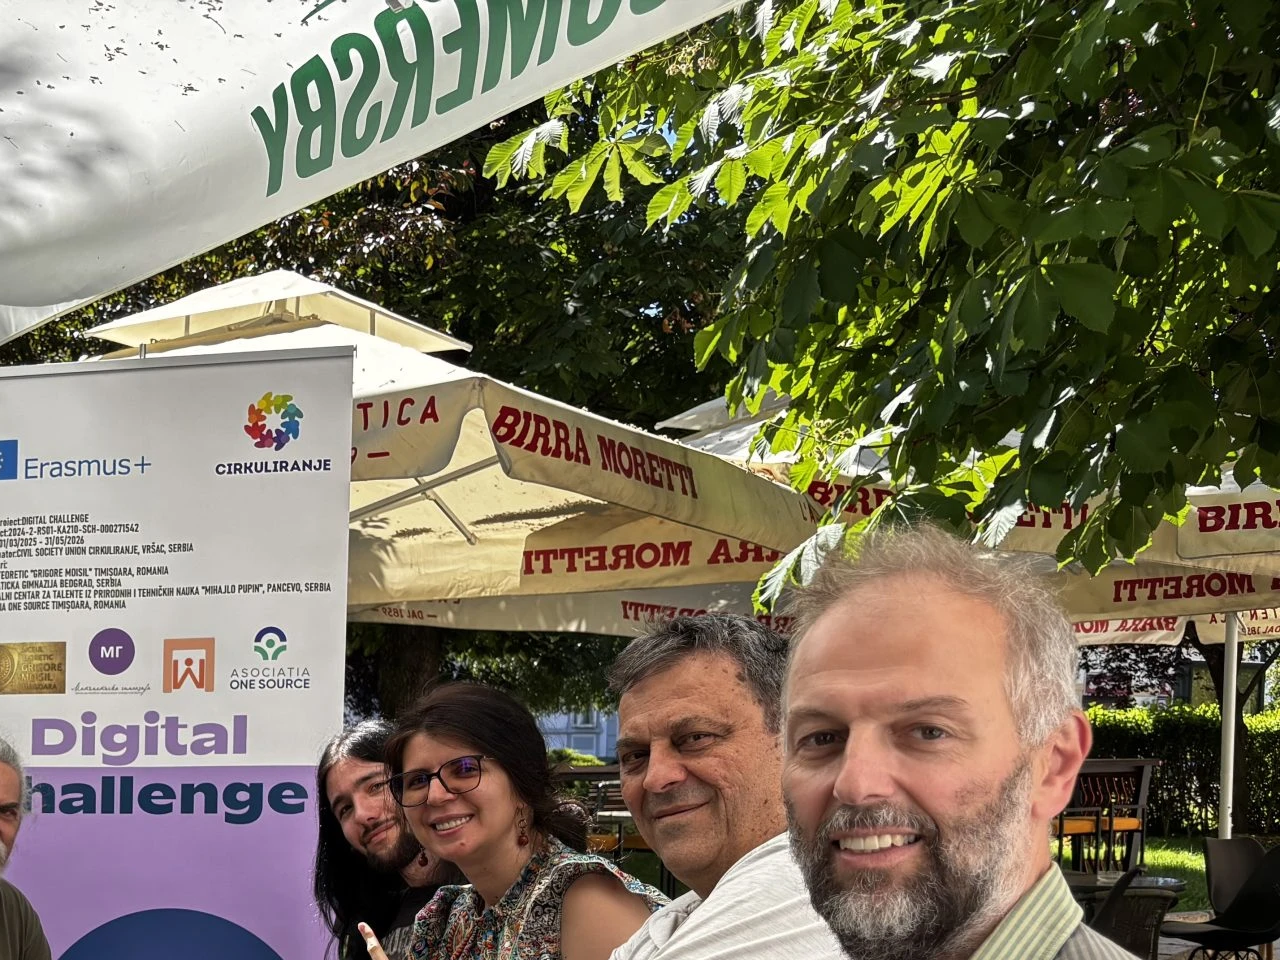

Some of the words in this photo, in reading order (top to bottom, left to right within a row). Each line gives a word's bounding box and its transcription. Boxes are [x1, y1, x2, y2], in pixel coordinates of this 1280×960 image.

[356, 395, 439, 431] TICA
[491, 405, 590, 466] BIRRA
[596, 434, 698, 499] MORETTI
[24, 455, 152, 480] Erasmus+
[215, 459, 331, 476] CIRKULIRANJE
[49, 514, 89, 524] CHALLENGE
[1197, 500, 1280, 532] BIR
[45, 536, 84, 546] 31/05/2026
[35, 547, 63, 556] SOCIETY
[66, 546, 86, 555] UNION
[89, 545, 140, 555] CIRKULIRANJE,
[142, 542, 166, 554] VRŠAC,
[168, 543, 193, 552] SERBIA
[136, 566, 169, 576] ROMANIA
[14, 591, 40, 600] CENTAR
[42, 591, 51, 599] ZA
[53, 590, 83, 599] TALENTE
[85, 590, 91, 598] IZ
[94, 589, 131, 598] PRIRODNIH
[176, 586, 199, 596] NAUKA
[267, 583, 302, 593] PANCEVO,
[305, 582, 331, 592] SERBIA
[22, 580, 57, 589] GIMNAZIJA
[60, 579, 94, 588] BEOGRAD,
[97, 578, 121, 587] SERBIA
[8, 602, 21, 611] ONE
[24, 601, 50, 610] SOURCE
[94, 600, 126, 609] ROMANIA
[230, 667, 311, 678] ASOCIATIA
[230, 679, 255, 690] ONE
[258, 678, 310, 689] SOURCE
[31, 710, 248, 766] Digital
[25, 776, 308, 825] hallenge
